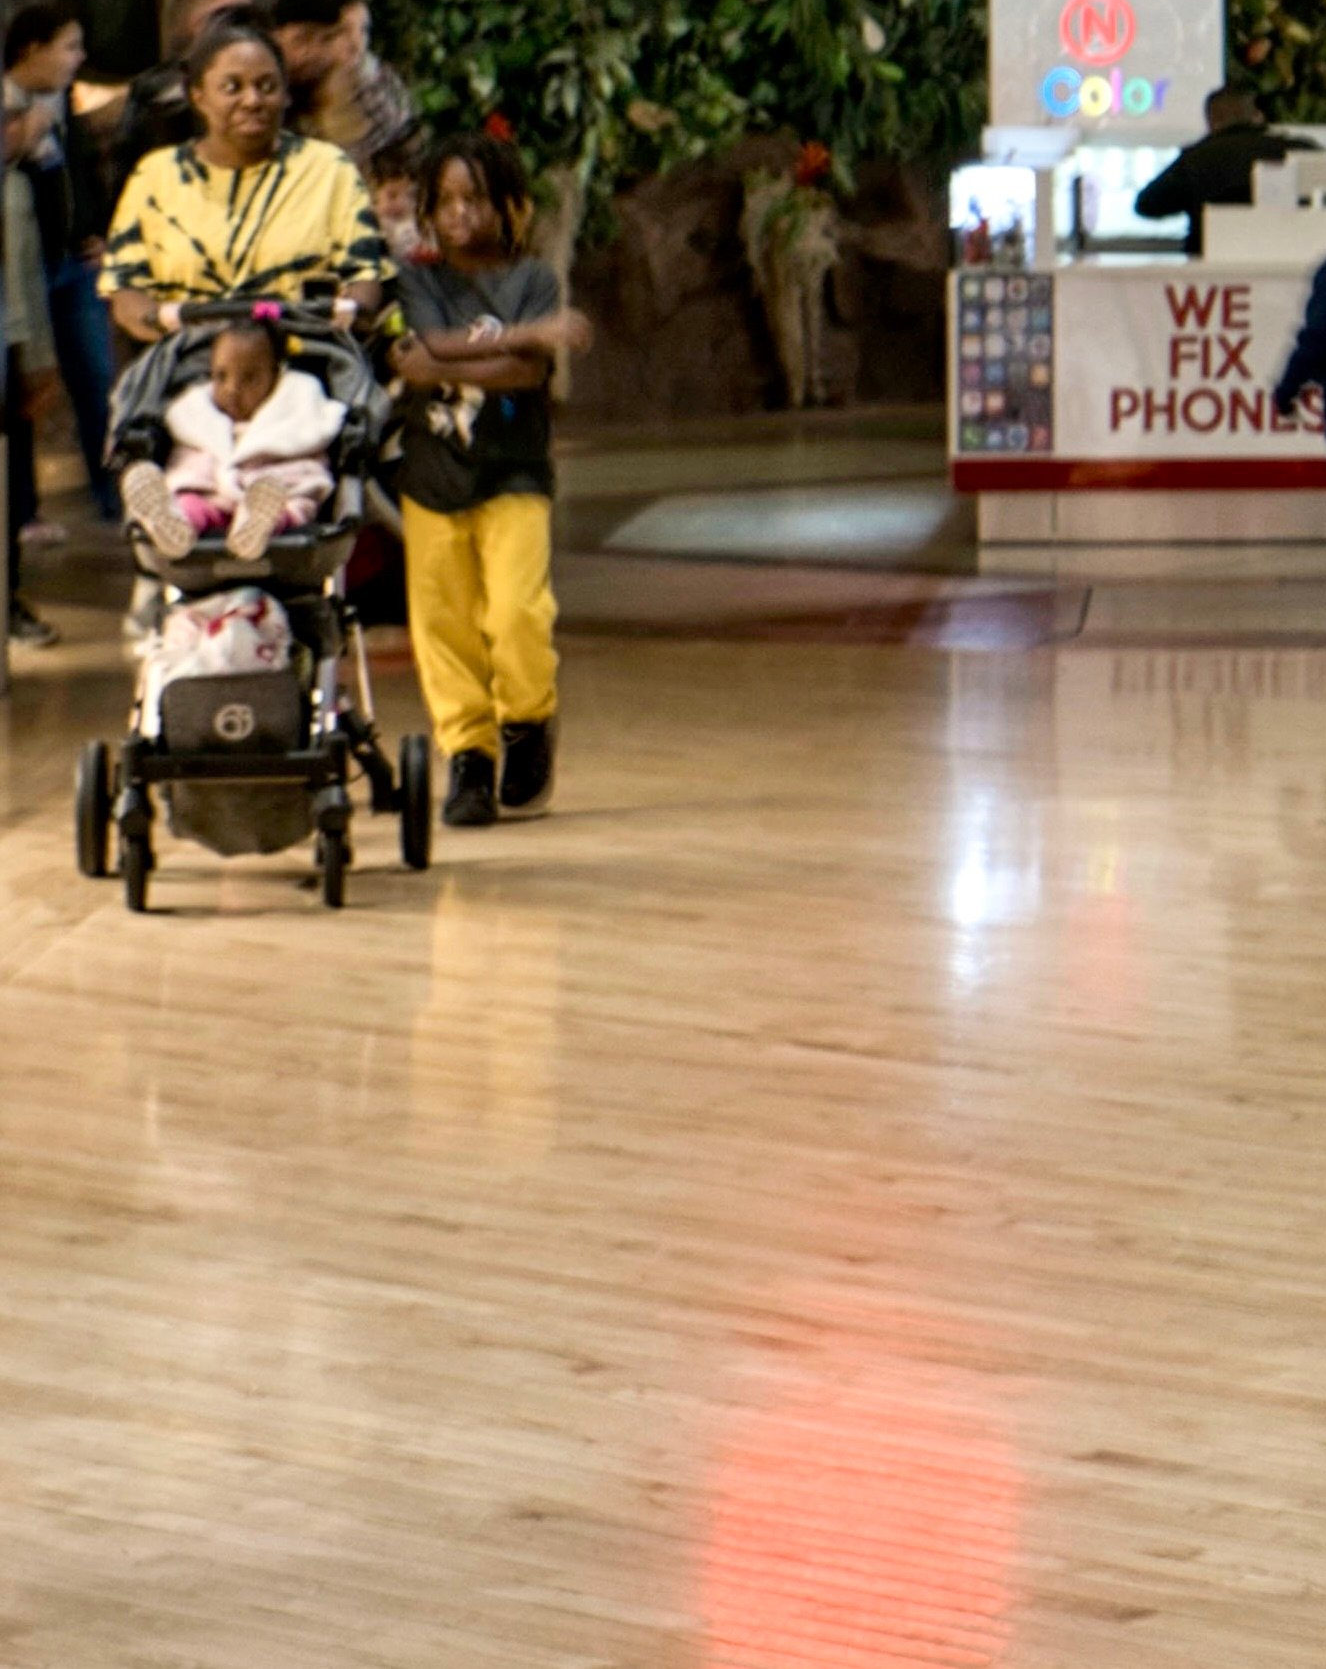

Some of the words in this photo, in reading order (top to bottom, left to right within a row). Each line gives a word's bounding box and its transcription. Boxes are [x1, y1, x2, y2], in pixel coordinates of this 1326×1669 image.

[1039, 65, 1171, 119] Color
[1165, 284, 1251, 329] WE
[1169, 334, 1252, 380] FIX
